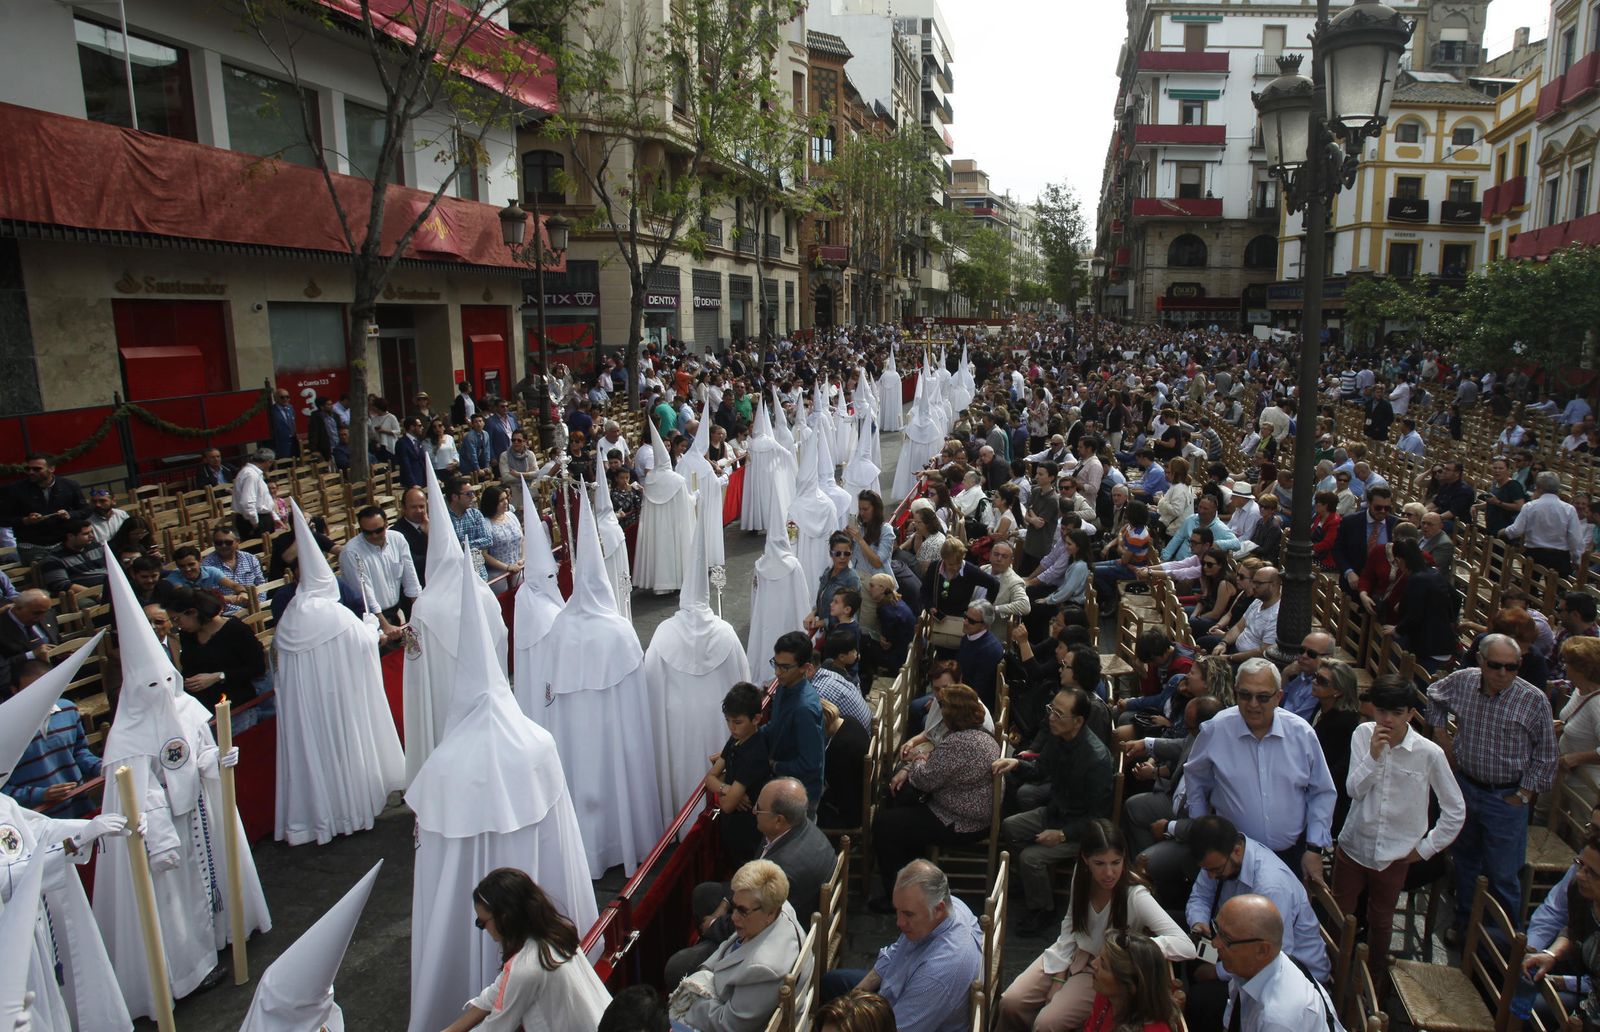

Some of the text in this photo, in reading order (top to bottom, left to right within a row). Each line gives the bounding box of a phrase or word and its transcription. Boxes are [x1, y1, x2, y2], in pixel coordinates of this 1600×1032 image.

[144, 276, 227, 295] Santander
[648, 295, 676, 305] DENTIX
[700, 298, 721, 307] DENTIX
[300, 388, 318, 416] 3
